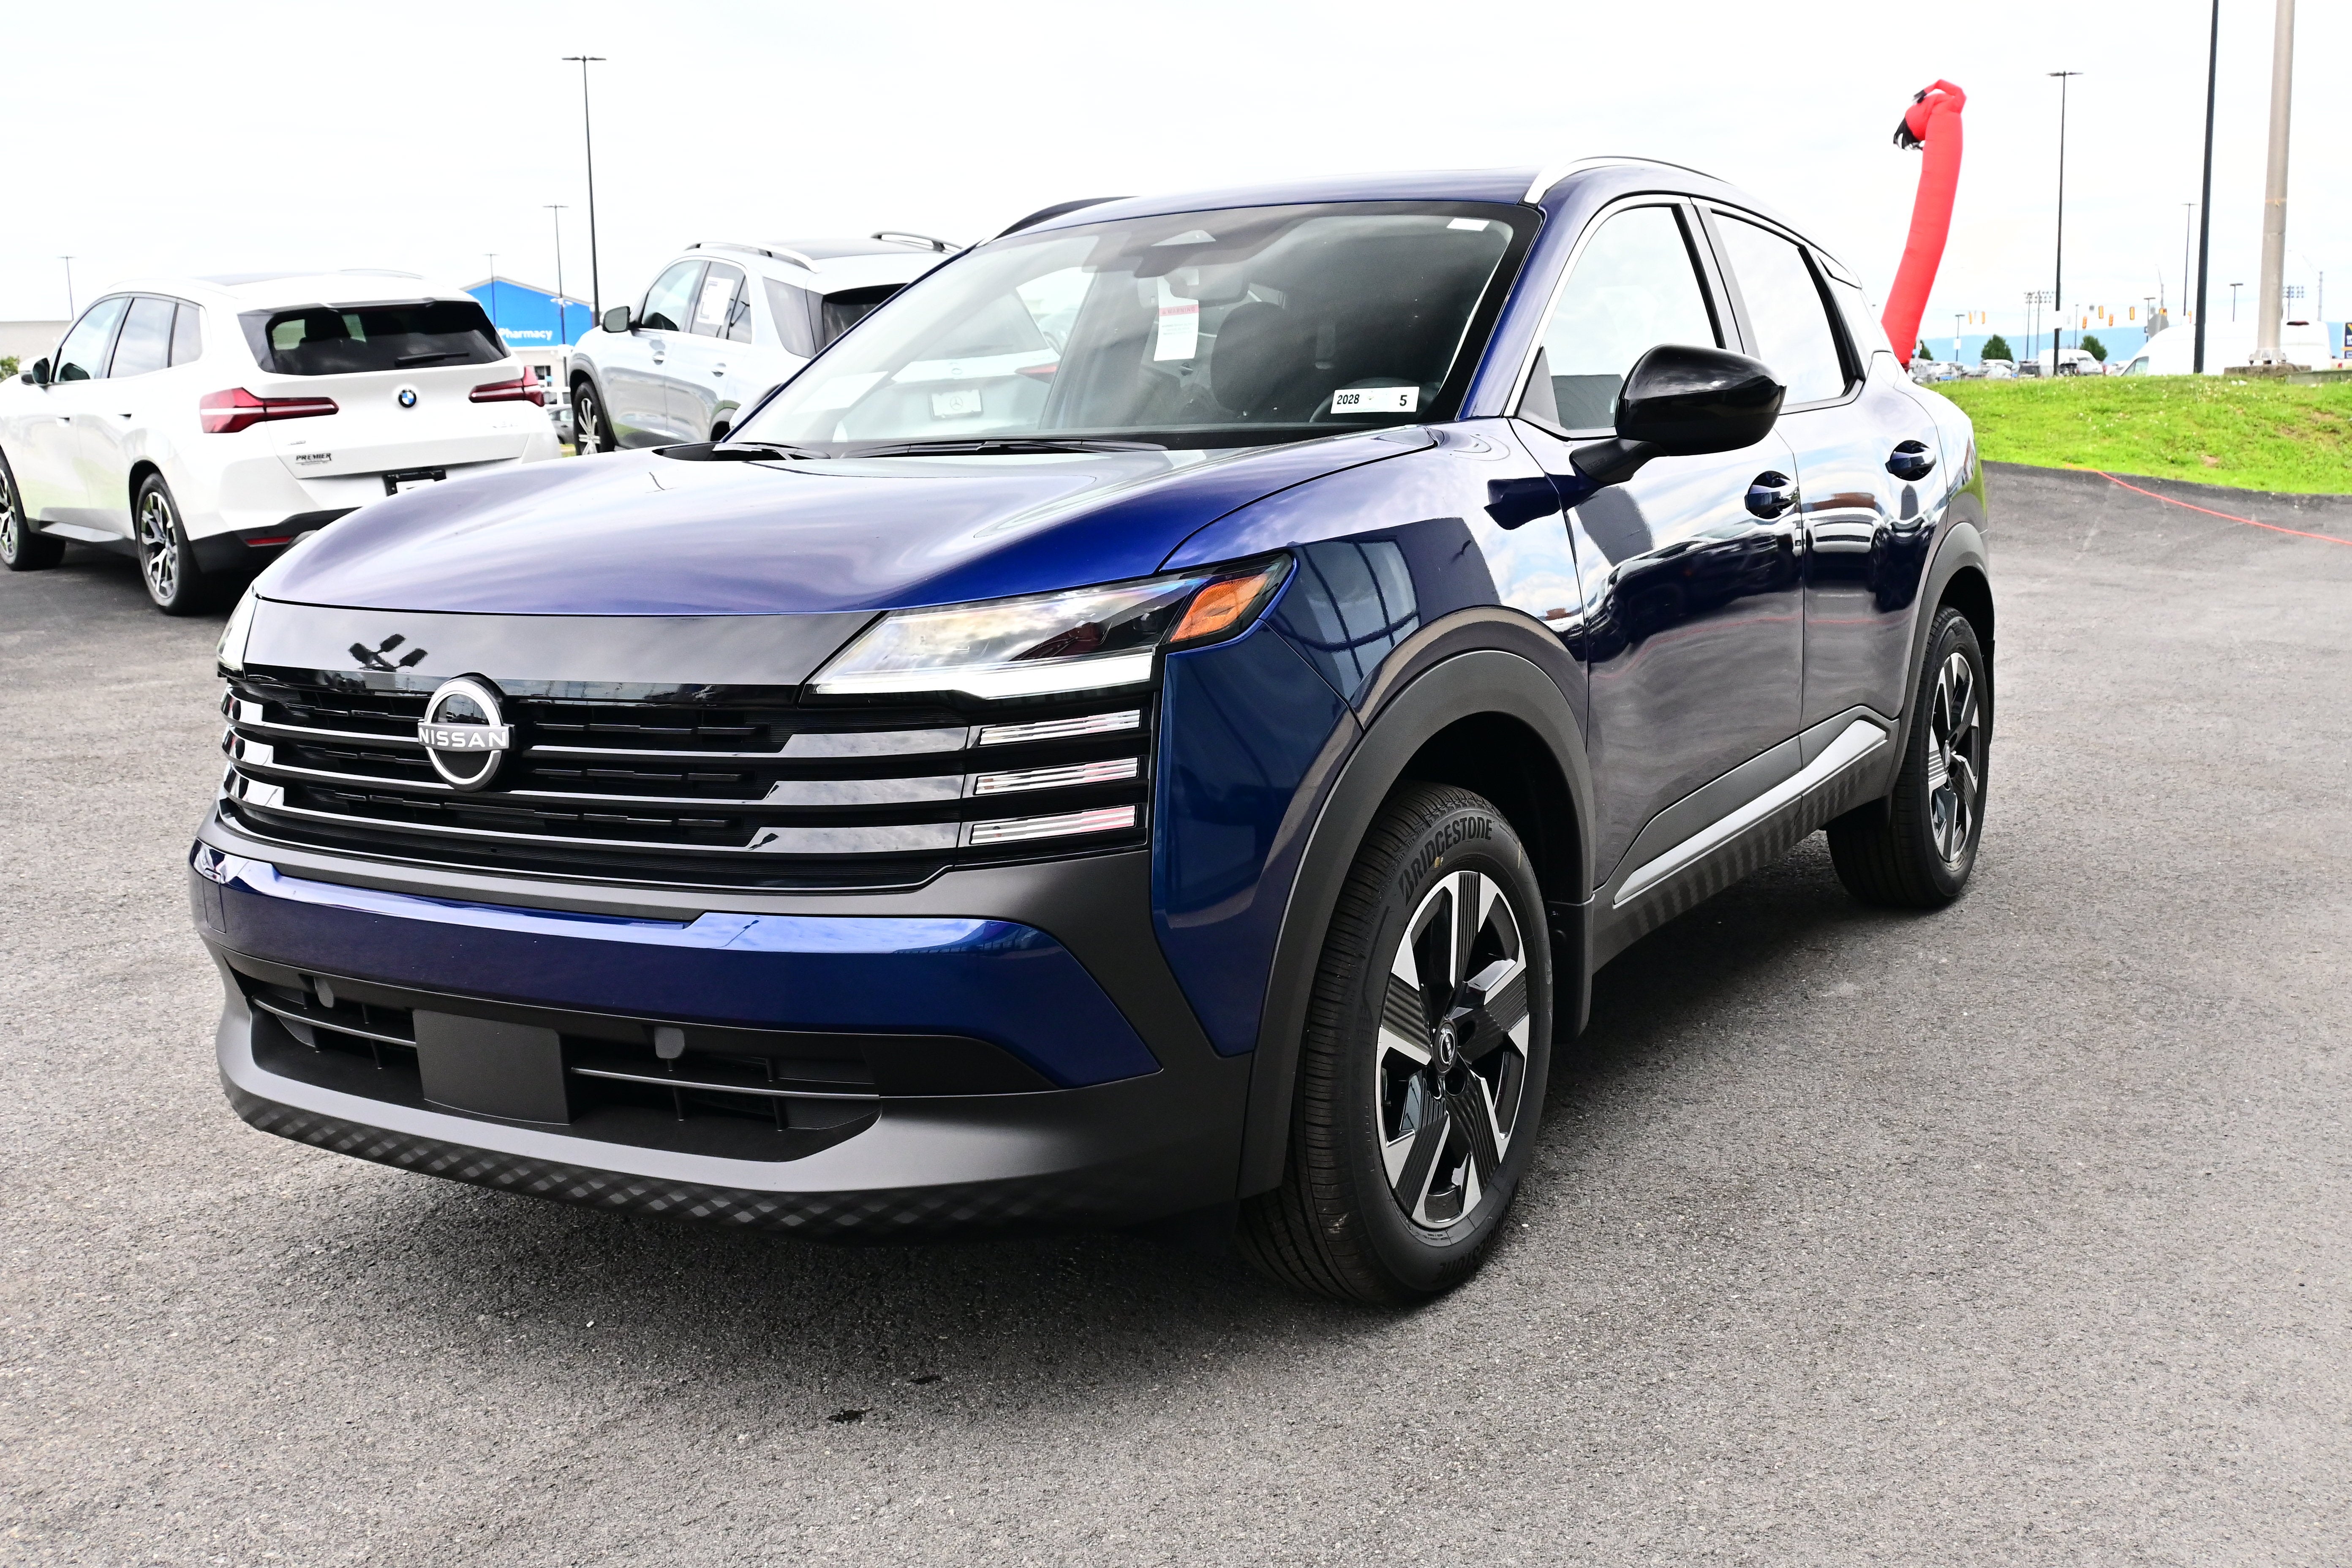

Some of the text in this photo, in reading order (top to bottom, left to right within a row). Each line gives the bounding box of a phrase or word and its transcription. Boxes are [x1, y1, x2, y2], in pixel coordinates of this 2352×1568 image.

[498, 328, 553, 340] Pharmacy
[1337, 394, 1407, 406] 2028 5
[296, 453, 331, 461] PREMIER
[419, 727, 506, 747] NISSAN
[1398, 816, 1493, 906] BRIDGESTONE
